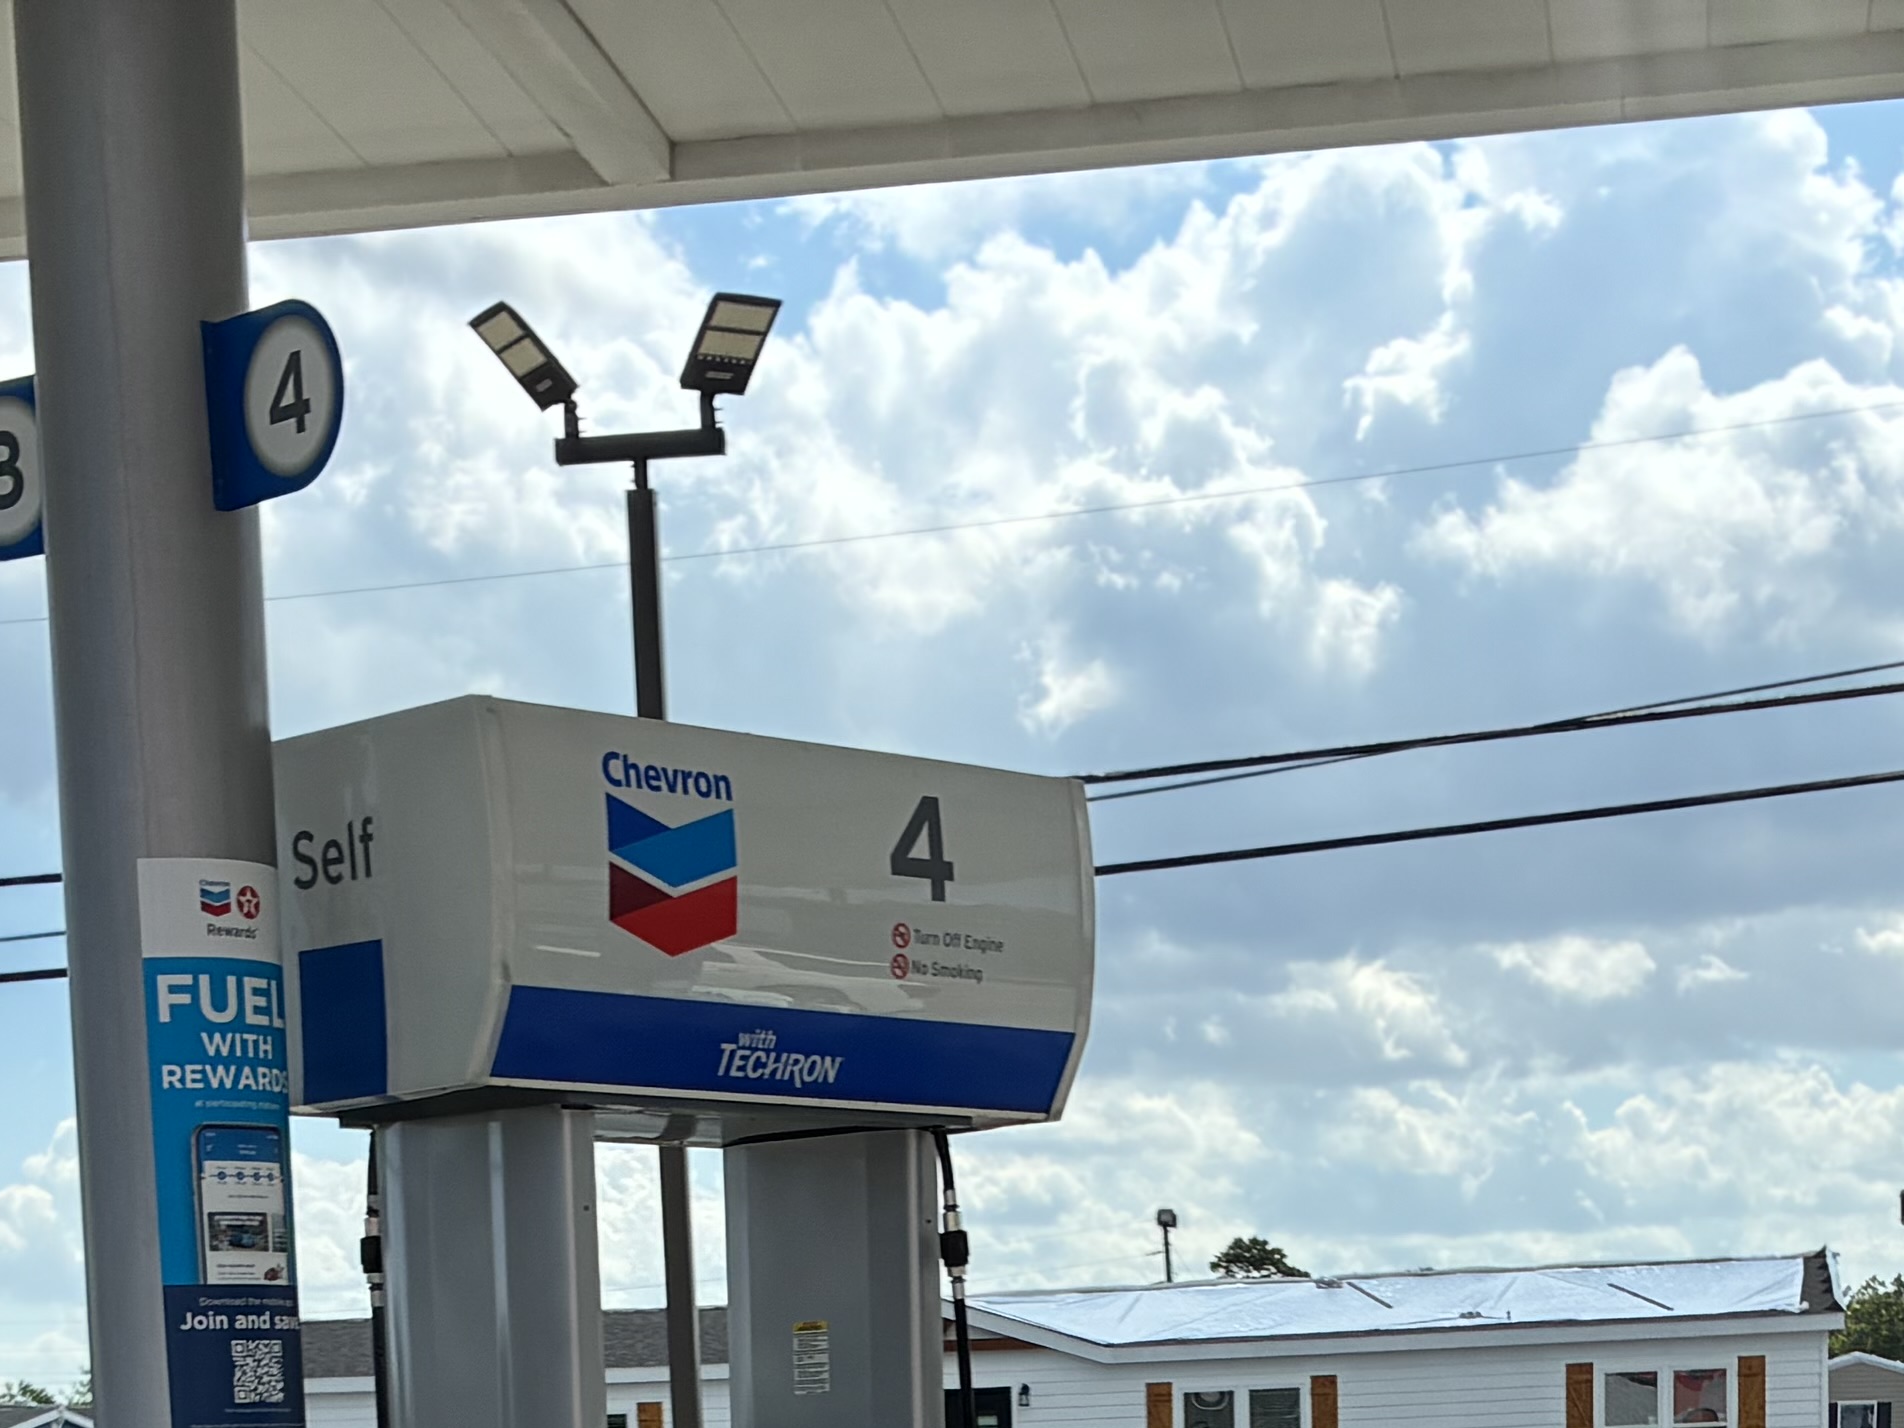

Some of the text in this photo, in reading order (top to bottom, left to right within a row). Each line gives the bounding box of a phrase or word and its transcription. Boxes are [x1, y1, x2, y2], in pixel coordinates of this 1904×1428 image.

[268, 349, 311, 434] 4
[602, 750, 733, 801] Chevron
[292, 815, 376, 891] Self
[890, 796, 955, 902] 4
[156, 974, 285, 1029] FUEL
[201, 1031, 273, 1060] WITH
[738, 1028, 778, 1049] with
[162, 1063, 288, 1094] REWARDS
[180, 1311, 229, 1331] Join
[234, 1310, 271, 1330] and
